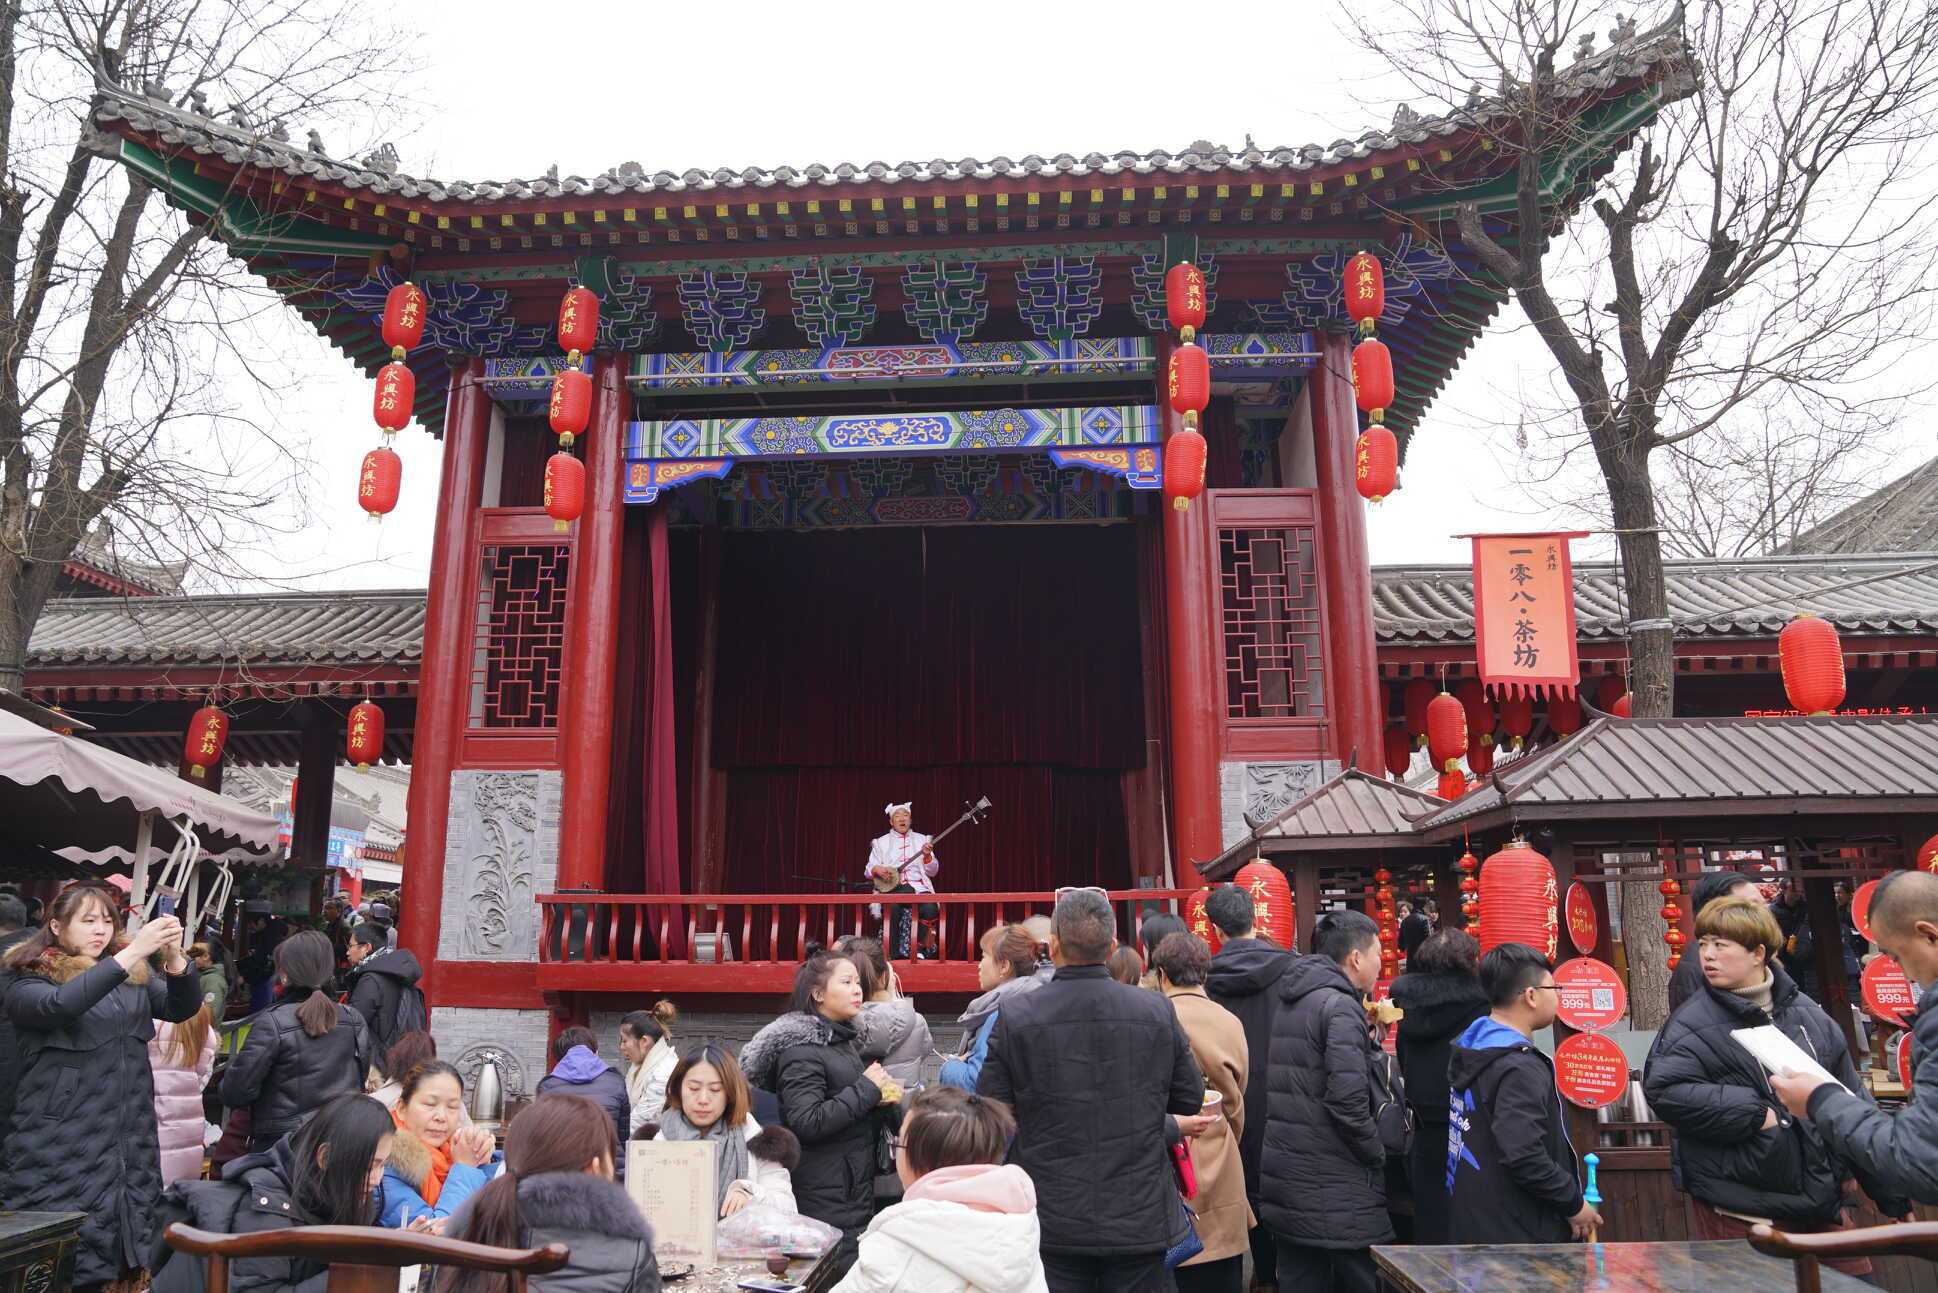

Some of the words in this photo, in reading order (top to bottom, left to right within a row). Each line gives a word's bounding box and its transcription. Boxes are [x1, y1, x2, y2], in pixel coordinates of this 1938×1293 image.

[1186, 269, 1201, 311] 永興坊
[1356, 258, 1374, 299] 永興坊
[400, 288, 420, 328] 永興坊
[562, 294, 578, 334] 永興坊
[380, 368, 400, 409] 永興坊
[361, 456, 376, 496] 永興坊
[200, 716, 221, 754] 永興坊
[351, 710, 368, 748] 永興坊
[1192, 900, 1211, 943] 永興
